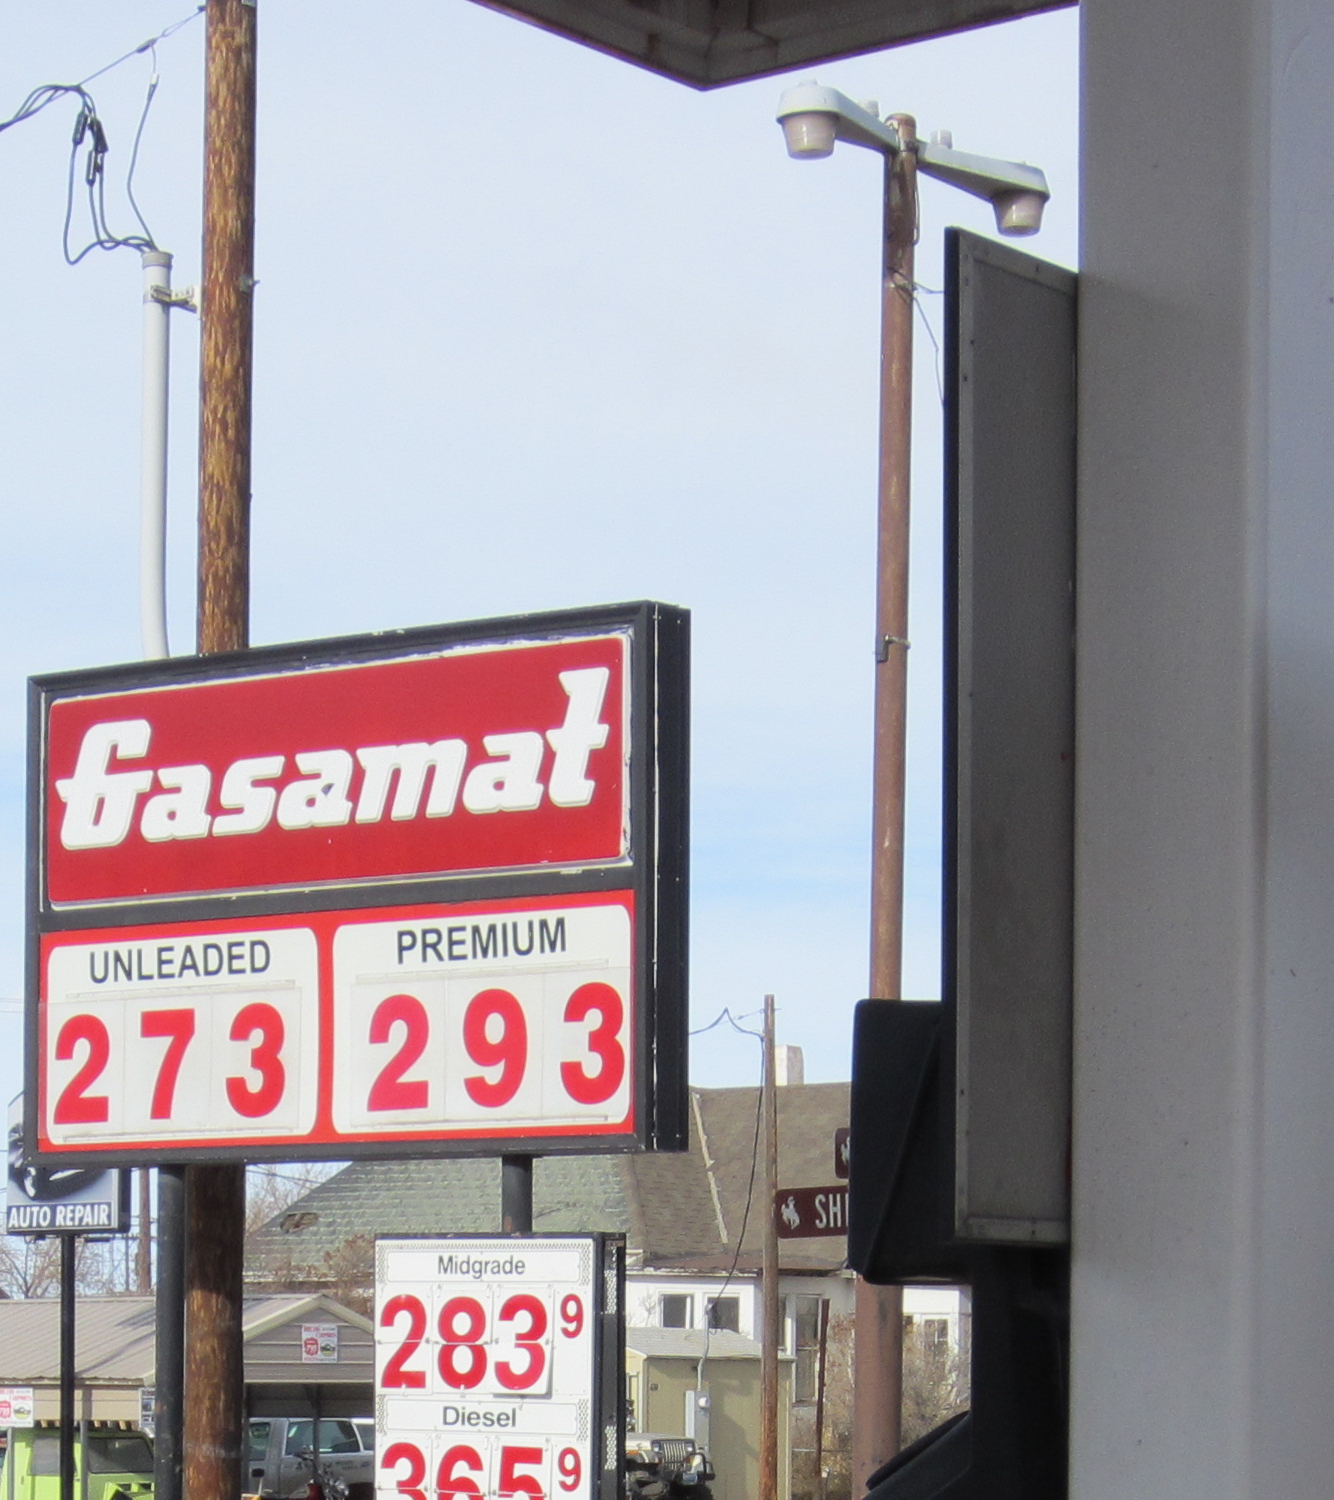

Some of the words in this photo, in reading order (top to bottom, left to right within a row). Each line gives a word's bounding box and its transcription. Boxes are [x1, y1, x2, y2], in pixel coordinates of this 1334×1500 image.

[55, 667, 610, 851] Gasamat
[89, 939, 271, 985] UNLEADED
[396, 918, 568, 965] PREMIUM
[53, 1002, 286, 1125] 273
[367, 982, 625, 1113] 293
[8, 1206, 51, 1229] AUTO
[56, 1204, 109, 1227] REPAIR
[437, 1255, 526, 1279] Midgrade
[442, 1406, 516, 1428] Diesel
